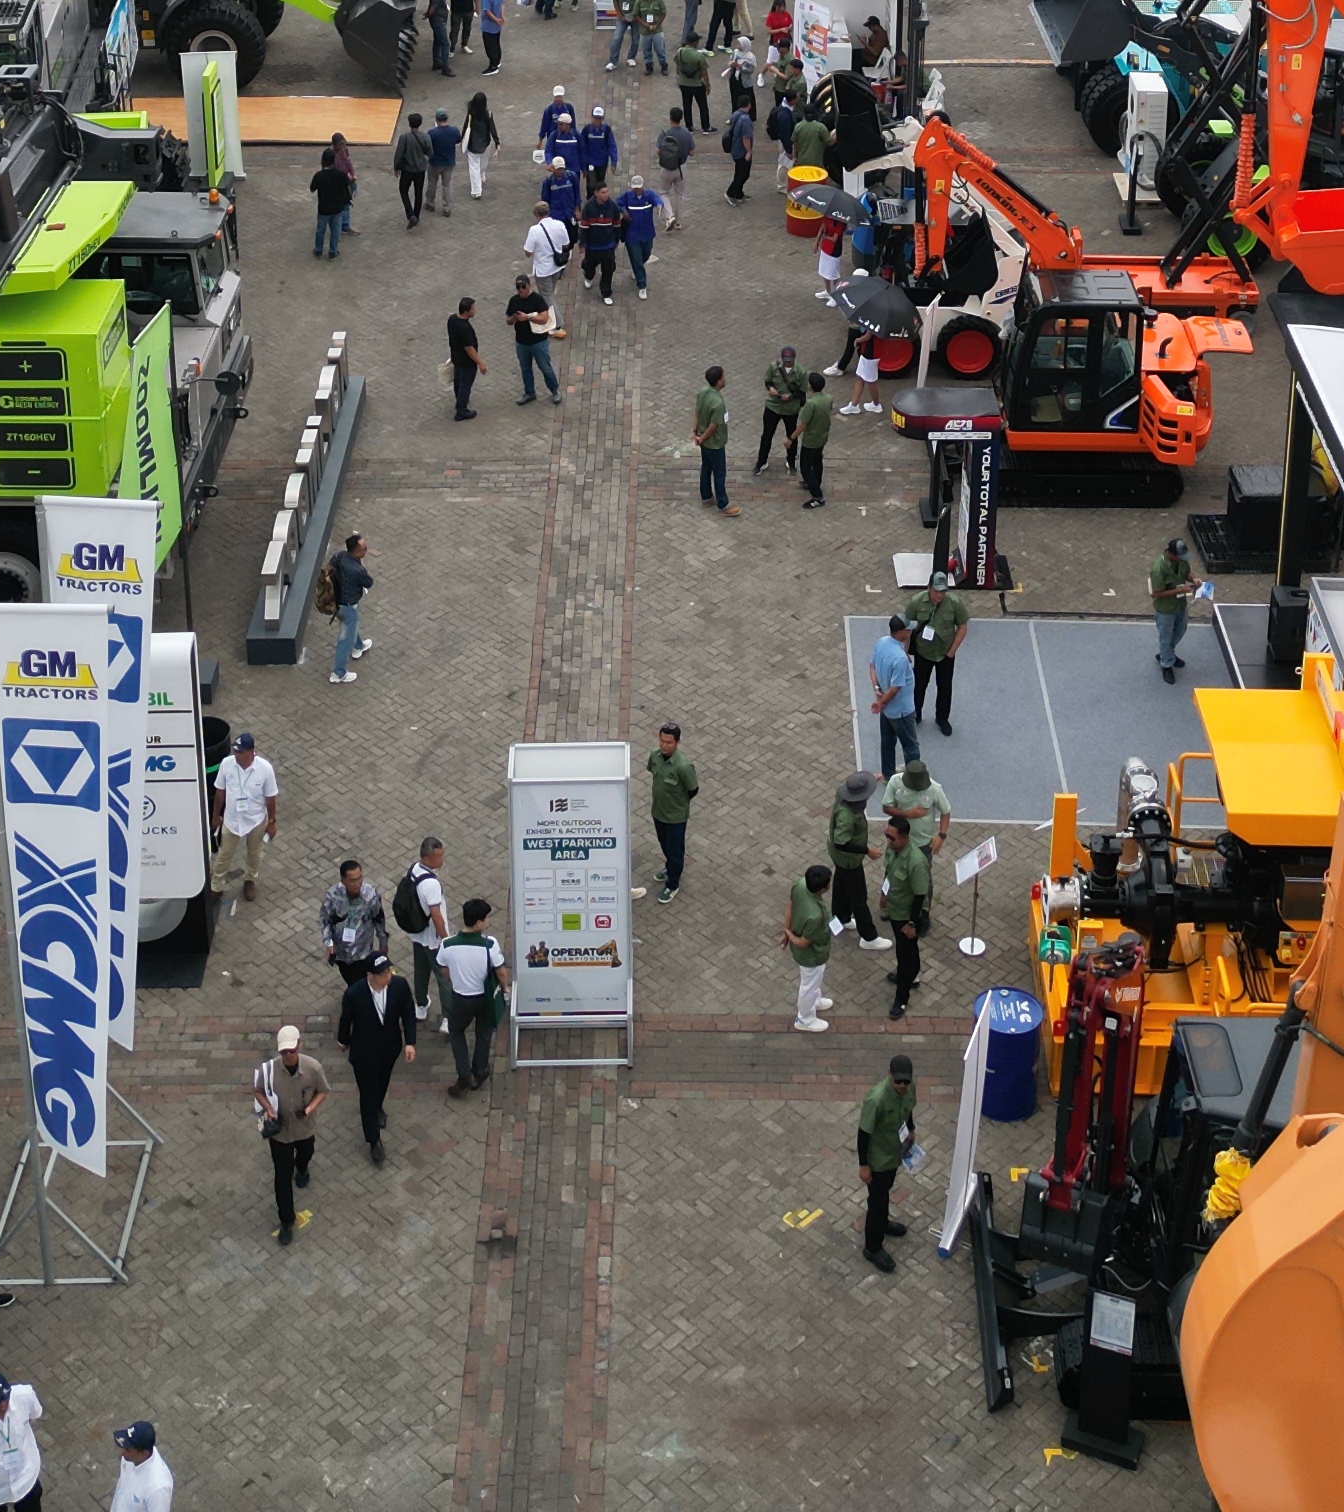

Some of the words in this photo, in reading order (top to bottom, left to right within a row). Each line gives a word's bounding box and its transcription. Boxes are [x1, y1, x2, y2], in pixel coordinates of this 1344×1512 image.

[975, 178, 1020, 217] LONKING
[6, 433, 57, 442] ZT160HEV
[980, 446, 992, 482] YOUR
[979, 482, 992, 525] TOTAL
[73, 542, 125, 572] GM
[976, 525, 988, 587] PARTNER
[56, 576, 144, 595] TRACTORS
[20, 649, 77, 678] GM
[1, 684, 98, 701] TRACTORS
[562, 819, 602, 827] OUTDOOR
[565, 827, 602, 835] ACTIVITY
[527, 839, 559, 849] WEST
[562, 838, 613, 848] PARKING
[554, 850, 586, 860] AREA
[551, 947, 614, 958] OPERATOR
[13, 831, 98, 1150] XCMG
